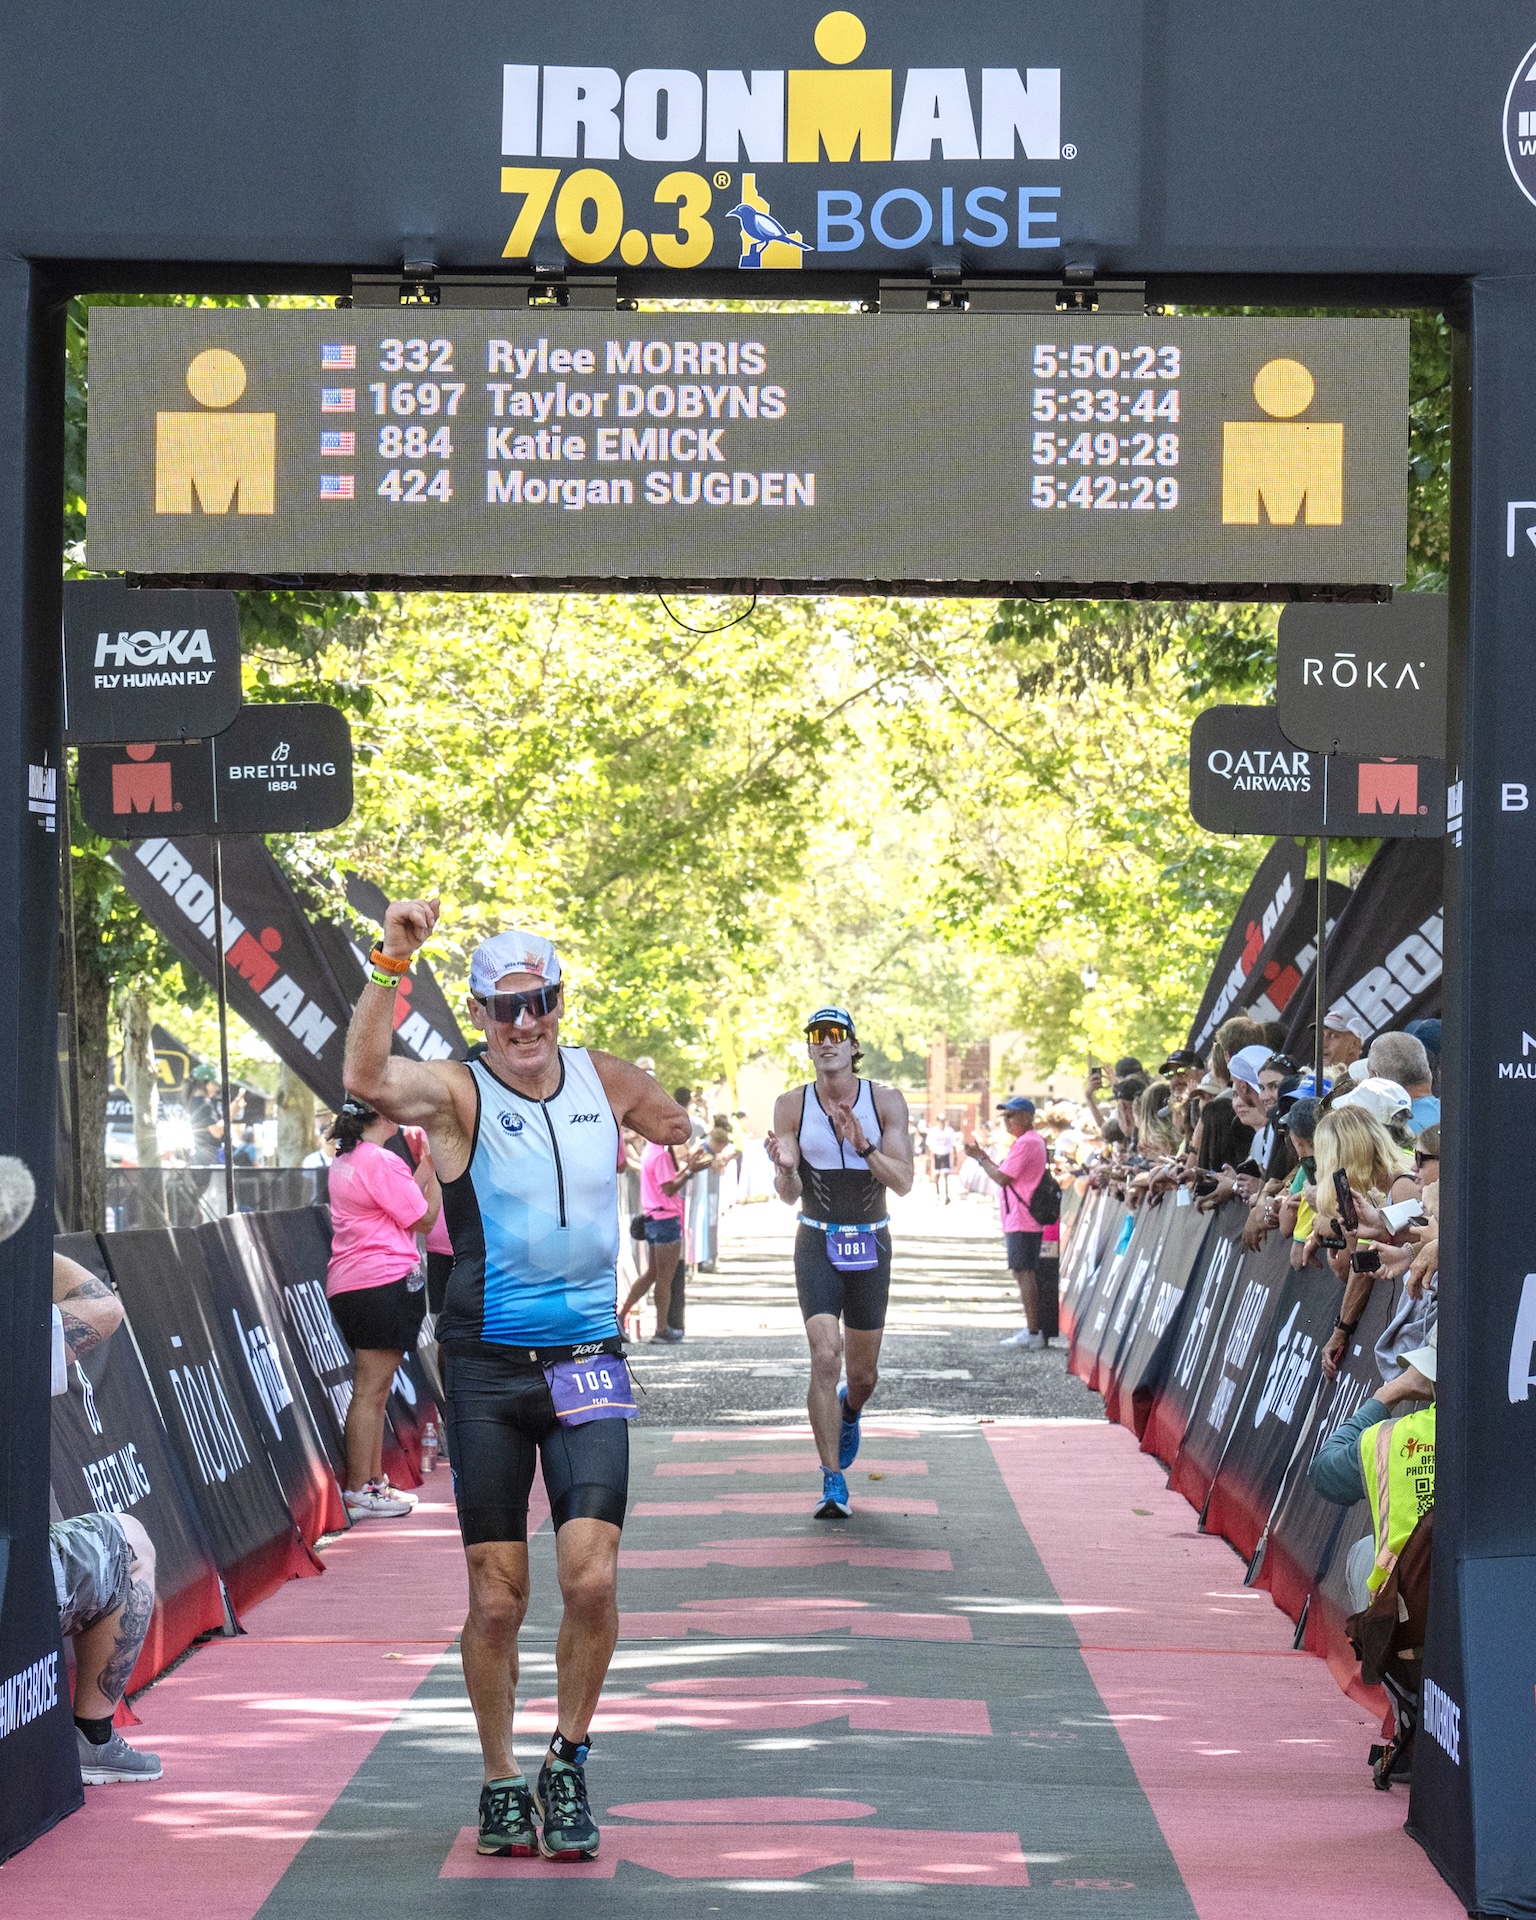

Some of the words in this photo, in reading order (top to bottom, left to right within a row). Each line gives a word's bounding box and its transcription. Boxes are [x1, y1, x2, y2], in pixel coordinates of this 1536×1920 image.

[816, 186, 1061, 253] BOISE
[379, 339, 453, 372] 332
[488, 339, 595, 378] Rylee
[606, 341, 766, 375] MORRIS
[1033, 345, 1181, 379] 5:50:23
[369, 382, 466, 416] 1697
[487, 382, 609, 421] Taylor
[618, 385, 787, 418] DOBYNS
[1032, 389, 1180, 423] 5:33:44
[378, 425, 453, 459] 884
[488, 426, 585, 460] Katie
[597, 428, 726, 462] EMICK
[1032, 432, 1179, 466] 5:49:28
[378, 469, 453, 502] 424
[487, 470, 633, 509] Morgan
[645, 472, 815, 506] SUGDEN
[1031, 475, 1179, 509] 5:42:29
[94, 629, 215, 667] HOKA
[94, 674, 121, 688] FLY
[123, 672, 184, 687] HUMAN
[187, 671, 214, 685] FLY
[229, 763, 336, 779] BREITLING
[1208, 750, 1311, 779] QATAR
[268, 781, 297, 791] 1884
[1233, 776, 1311, 792] AIRWAYS
[837, 1242, 866, 1256] 1081
[572, 1370, 613, 1393] 109
